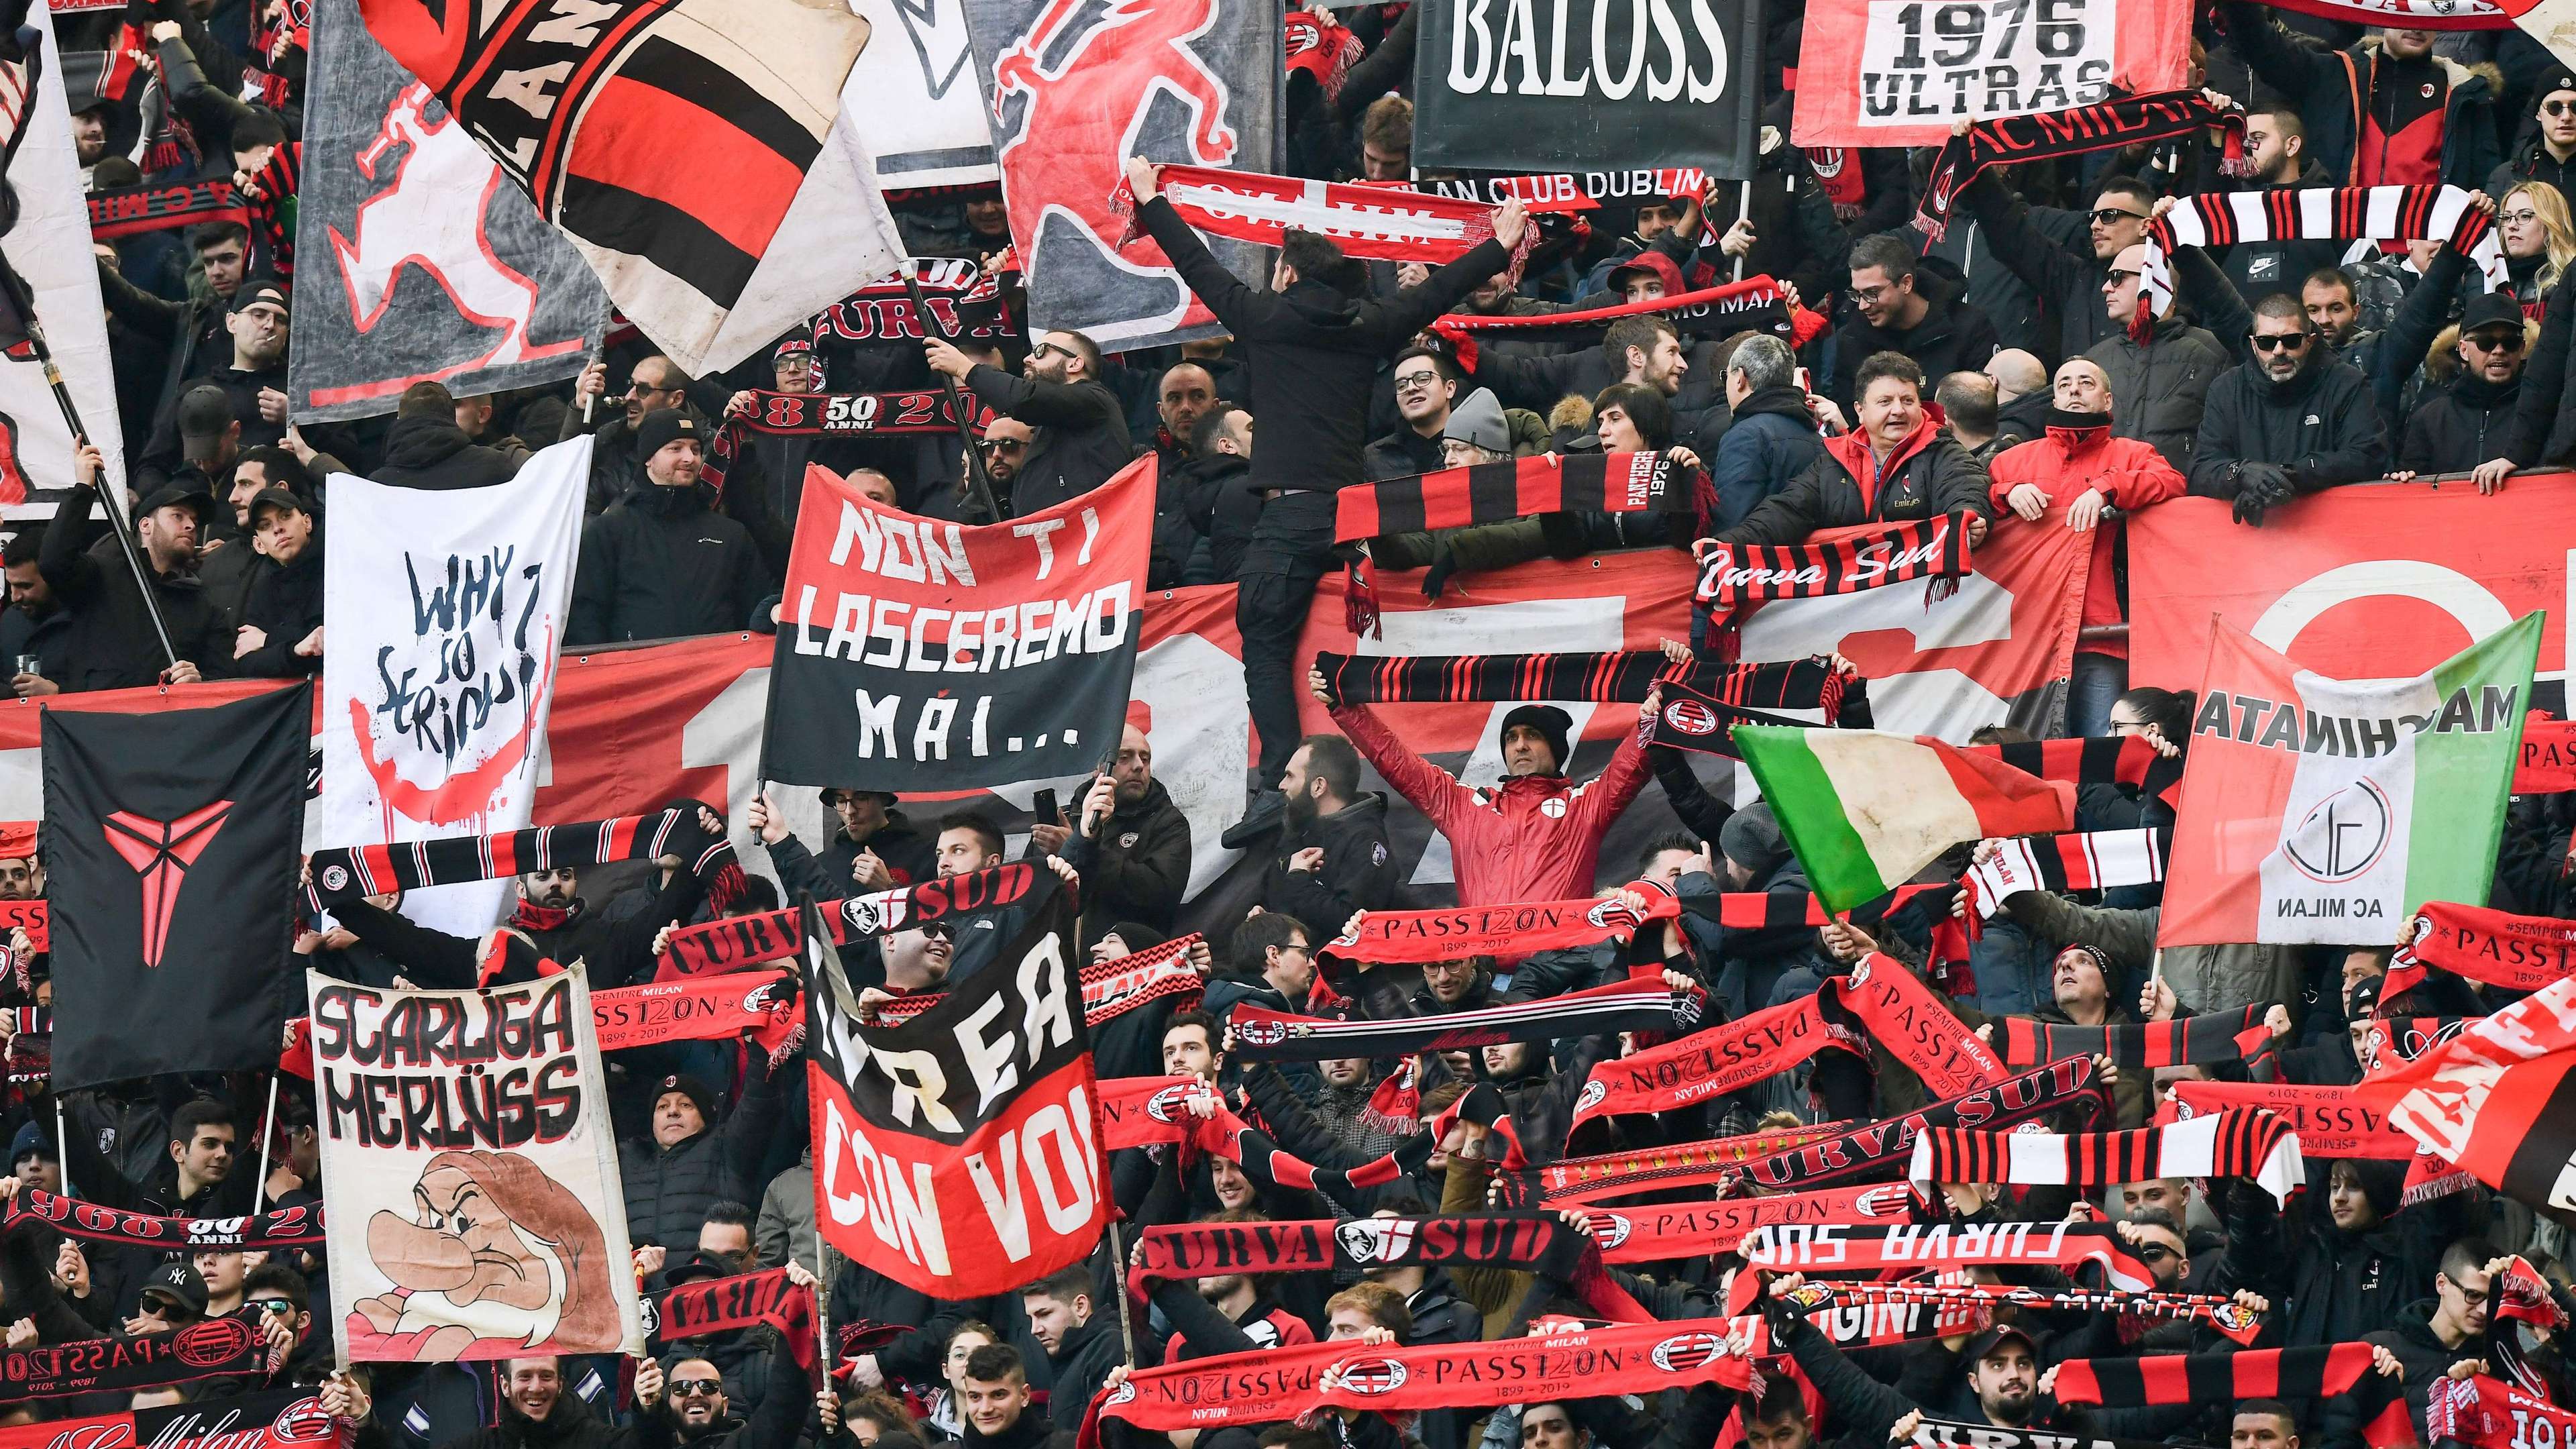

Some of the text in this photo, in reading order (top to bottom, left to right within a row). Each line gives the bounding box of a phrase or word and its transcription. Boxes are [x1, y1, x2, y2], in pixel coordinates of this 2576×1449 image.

[1893, 0, 2086, 68] 1976
[1863, 58, 2110, 117] ULTRAS
[1968, 116, 2037, 162] AC
[1818, 164, 1838, 174] 1899
[1488, 173, 1577, 206] CLUB
[1585, 168, 1707, 199] DUBLIN
[2253, 257, 2272, 268] NIKE
[1719, 289, 1773, 315] MAI
[825, 396, 878, 421] 50
[823, 419, 875, 430] ANNI
[1649, 460, 1670, 497] 1976
[829, 496, 1102, 588] NON TI
[1697, 524, 1949, 598] Curva Sud
[404, 544, 515, 639] WHY
[794, 580, 1132, 674] LASCEREMO
[915, 862, 1034, 922] SUD
[1440, 942, 1468, 953] 1899
[1480, 938, 1510, 949] 2019
[2514, 972, 2543, 983] 1899
[601, 1034, 626, 1044] 1899
[640, 1028, 667, 1038] 2019
[1908, 1049, 1931, 1071] 1899
[323, 1054, 583, 1150] MERLÜSS
[1150, 1092, 1168, 1116] ACM
[1953, 1055, 2093, 1130] SUD
[2315, 1091, 2343, 1101] 1899
[823, 1083, 1102, 1277] CON VOI
[2424, 1160, 2446, 1175] 120
[186, 1233, 244, 1245] ANNI
[1142, 1218, 1554, 1273] CURVA SUD
[1711, 1235, 1738, 1247] 1899
[1879, 1221, 2077, 1260] CURVA
[1655, 1342, 1669, 1366] ACM
[1390, 1362, 1406, 1387] ACM
[1495, 1385, 1524, 1397] 1899
[1540, 1383, 1570, 1394] 2019
[282, 1407, 299, 1435] ACM
